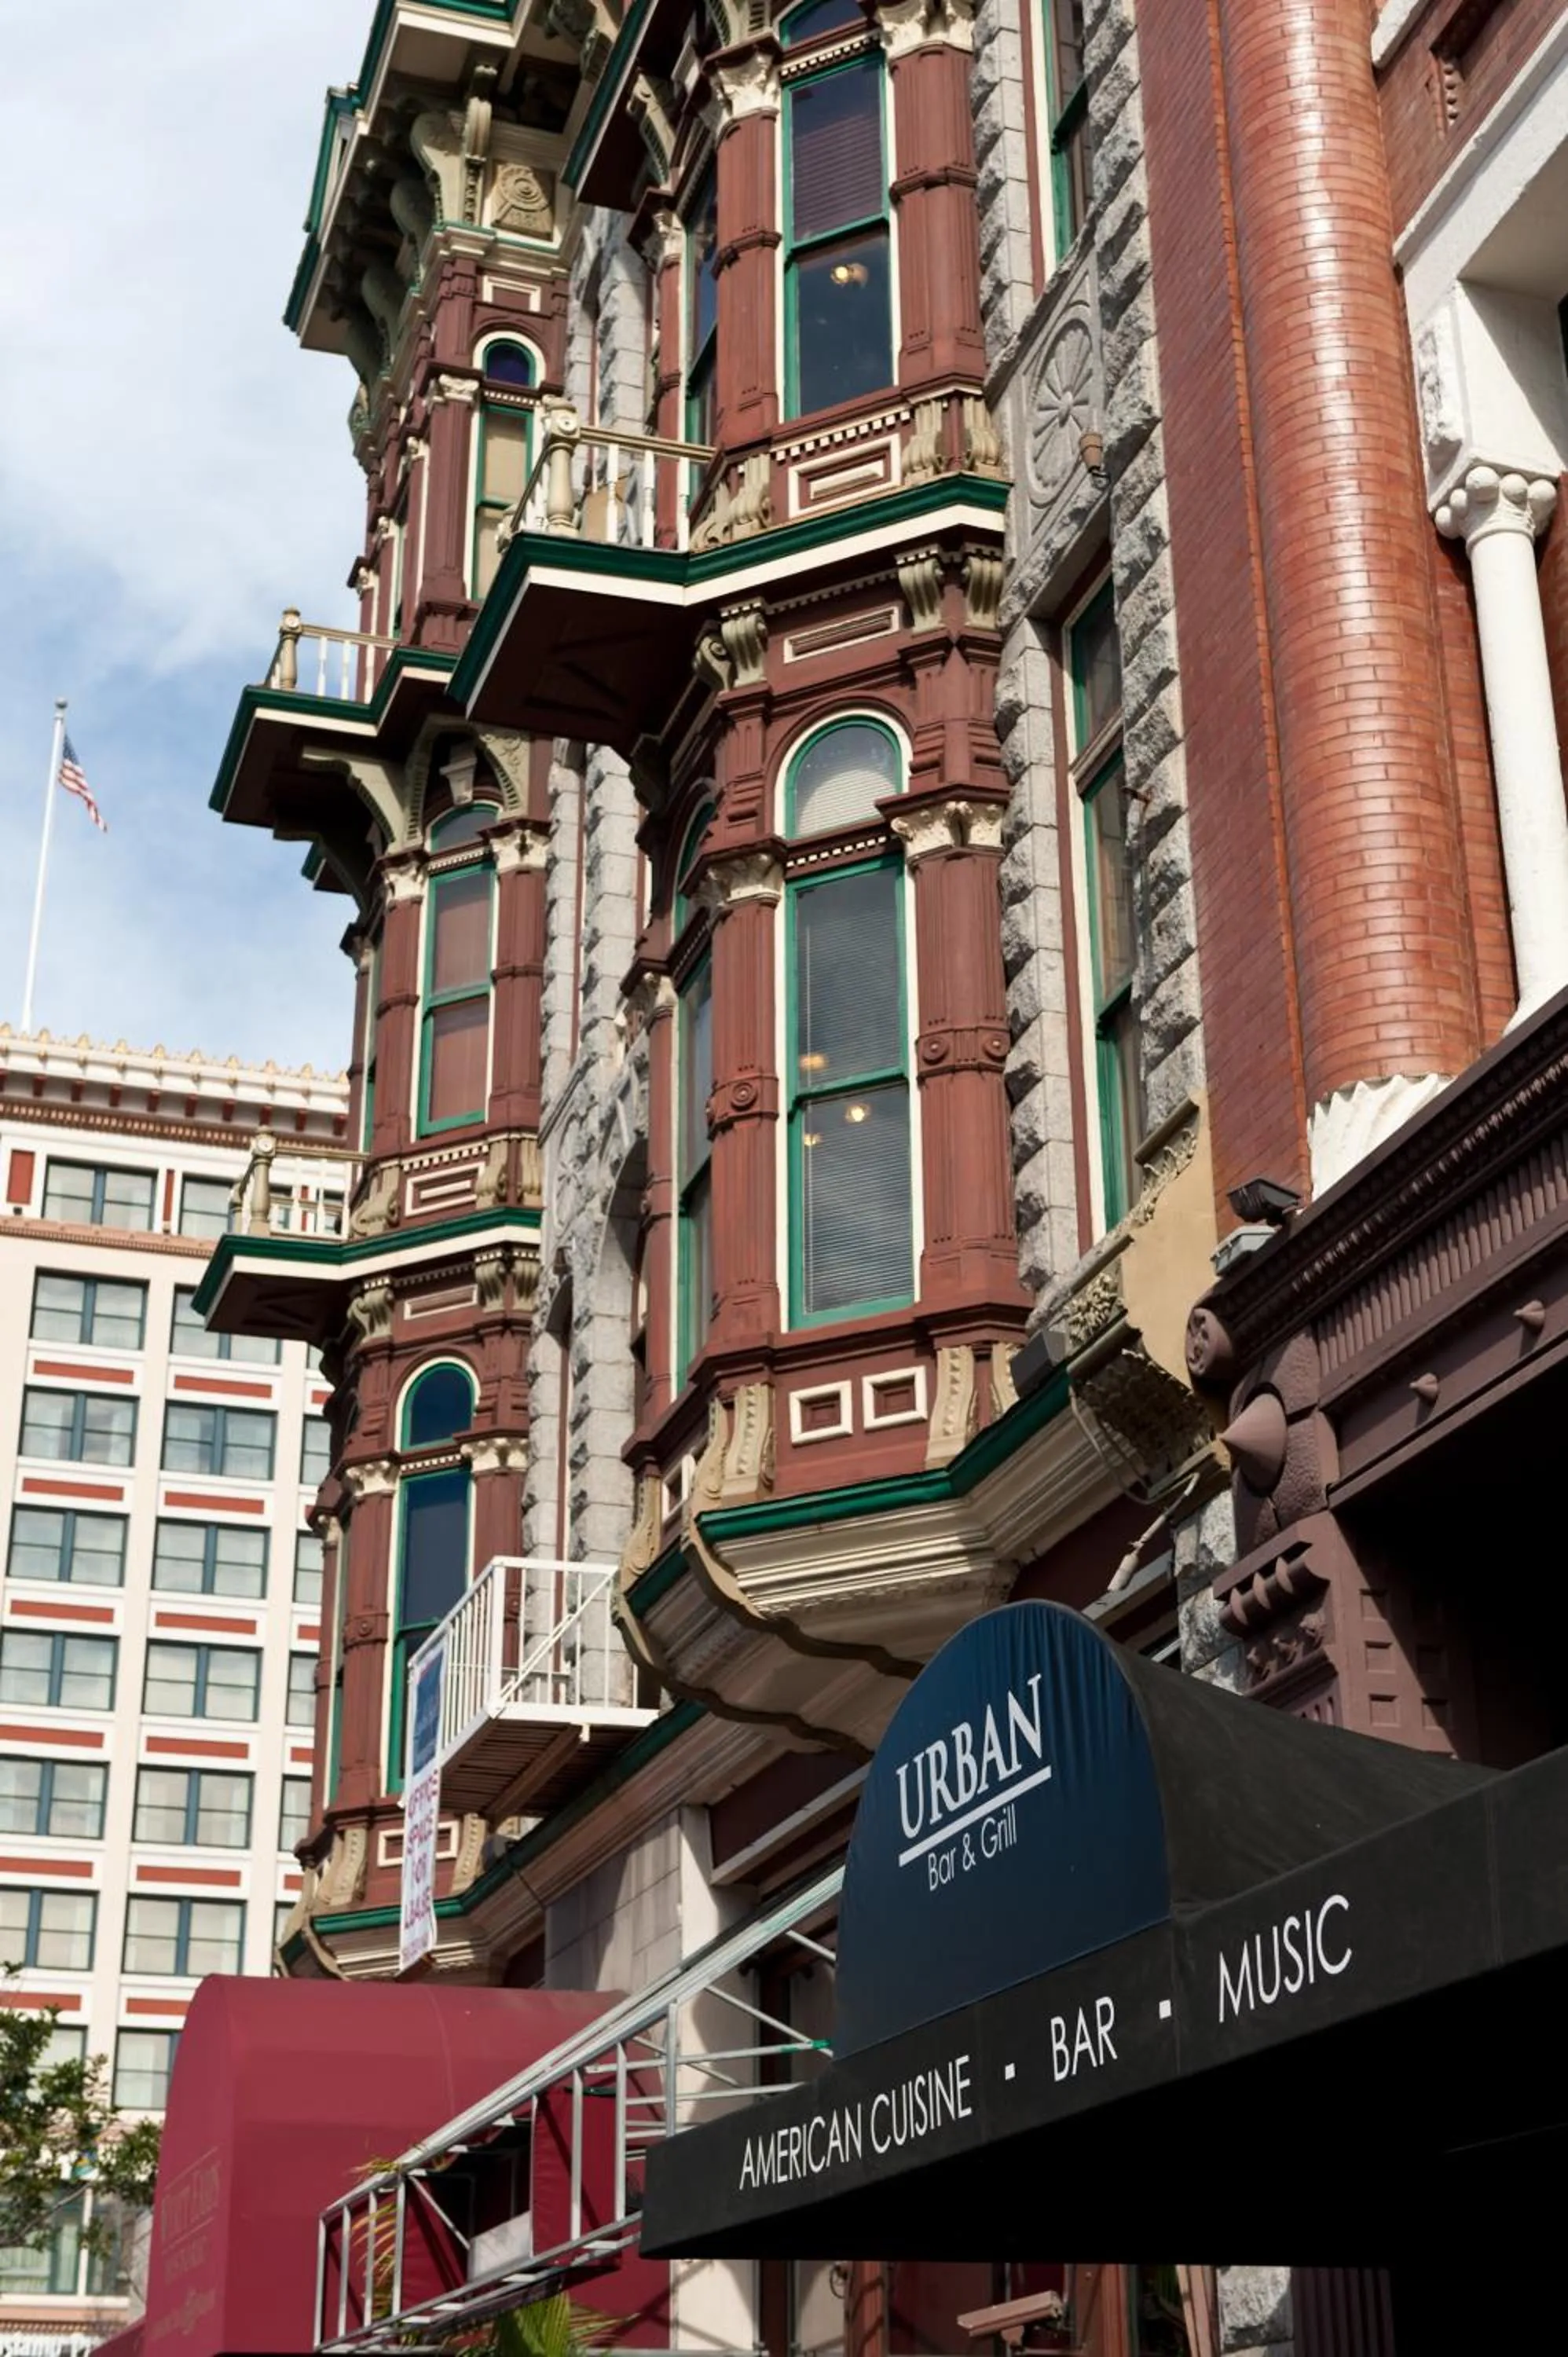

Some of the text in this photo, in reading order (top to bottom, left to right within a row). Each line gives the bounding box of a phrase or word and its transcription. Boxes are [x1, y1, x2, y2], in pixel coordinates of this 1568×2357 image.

[896, 1673, 1042, 1839] URBAN
[928, 1803, 1017, 1891] Bar & Grill
[738, 1894, 1354, 2190] AMERICAN CUISINE BAR MUSIC
